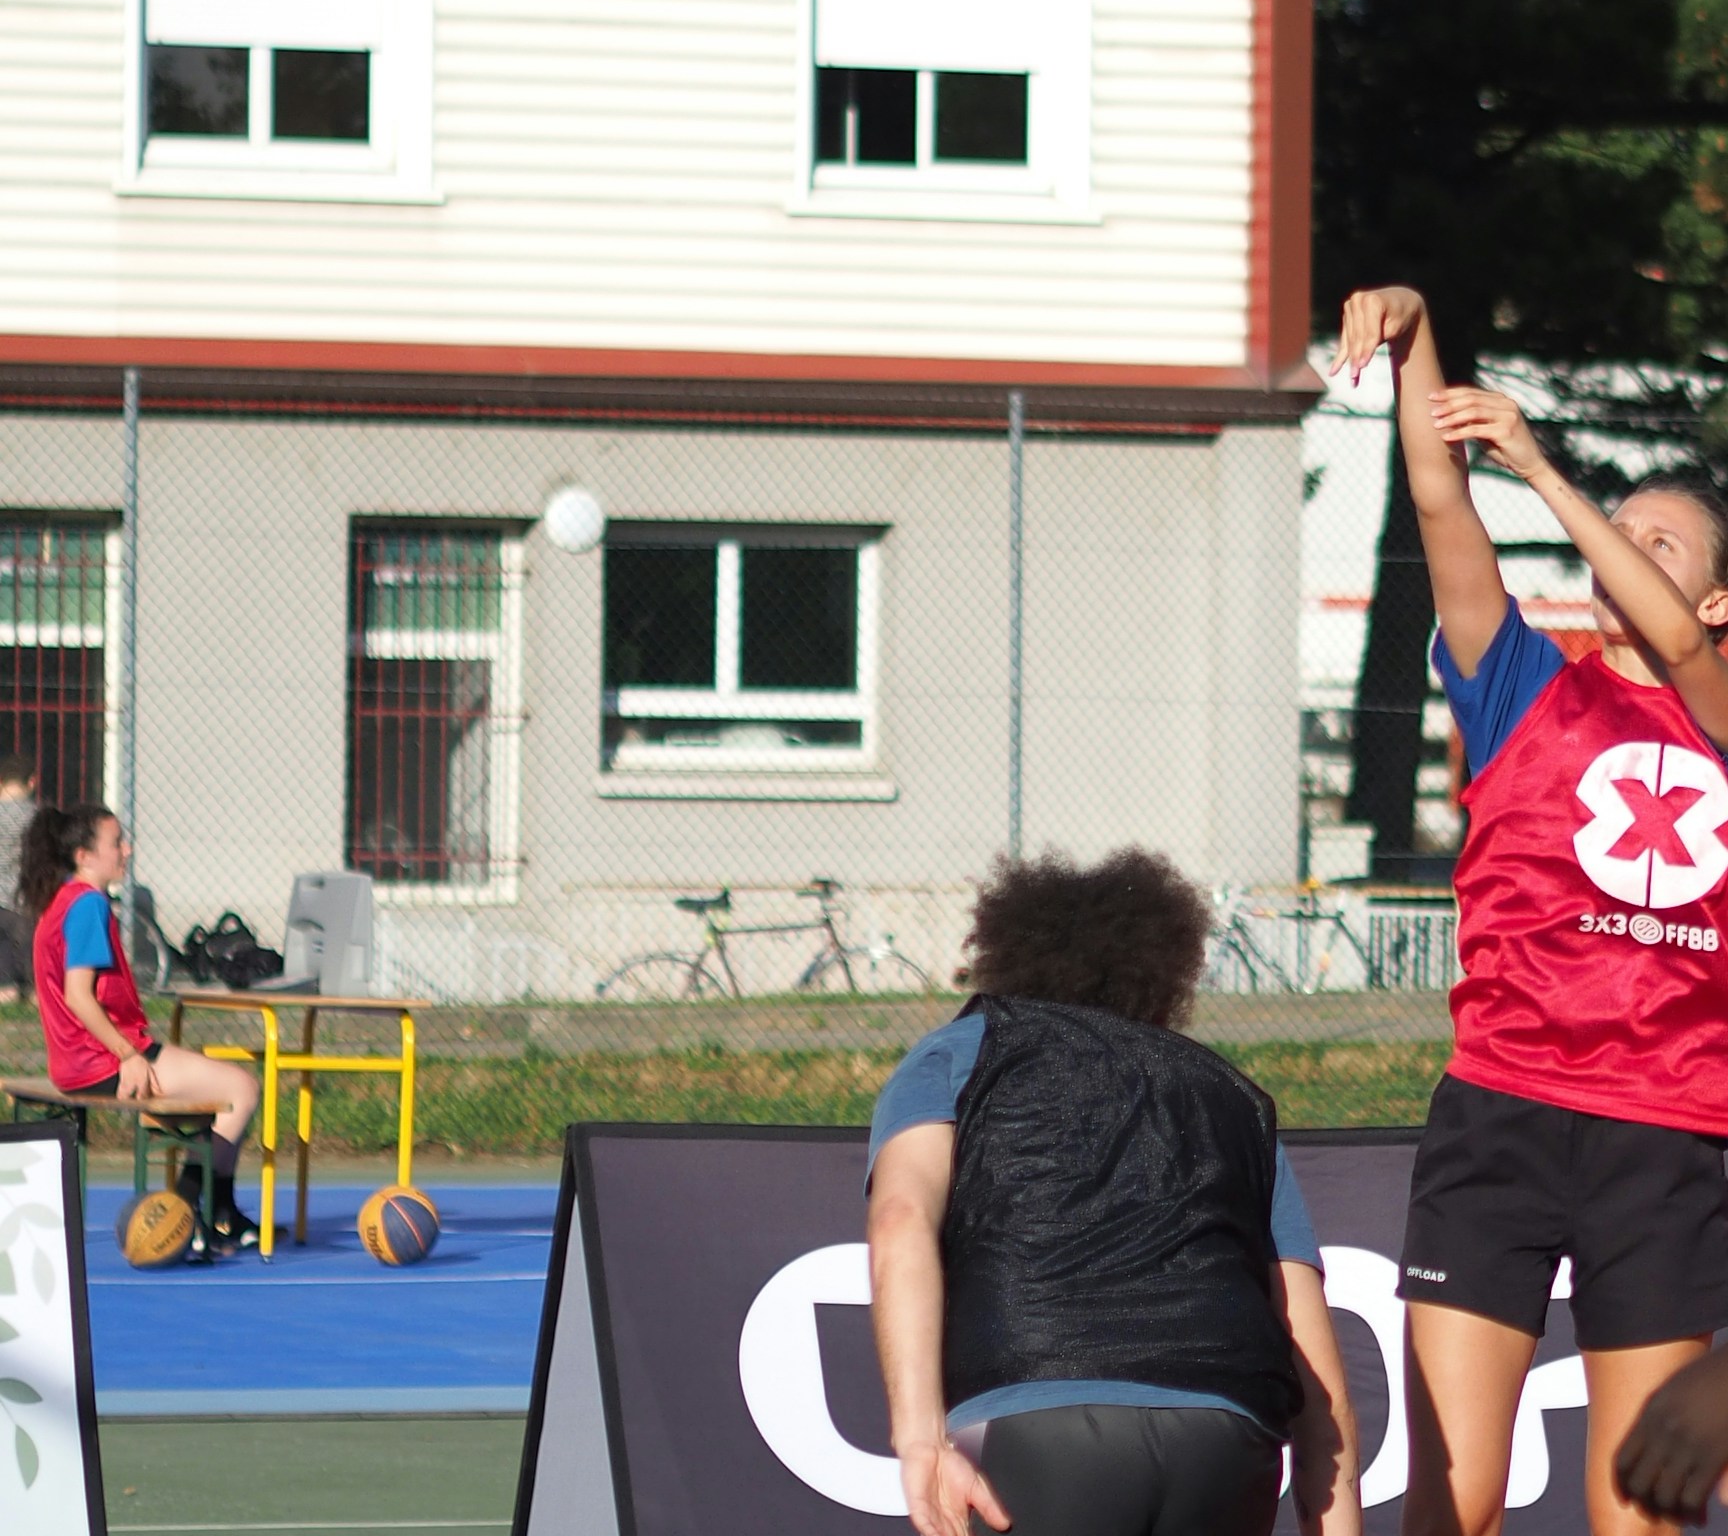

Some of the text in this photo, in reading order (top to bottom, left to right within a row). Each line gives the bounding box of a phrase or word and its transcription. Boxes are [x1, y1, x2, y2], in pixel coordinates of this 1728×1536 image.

[1578, 913, 1719, 952] 3X3 FFBB
[1407, 1267, 1445, 1282] OFFLOAD
